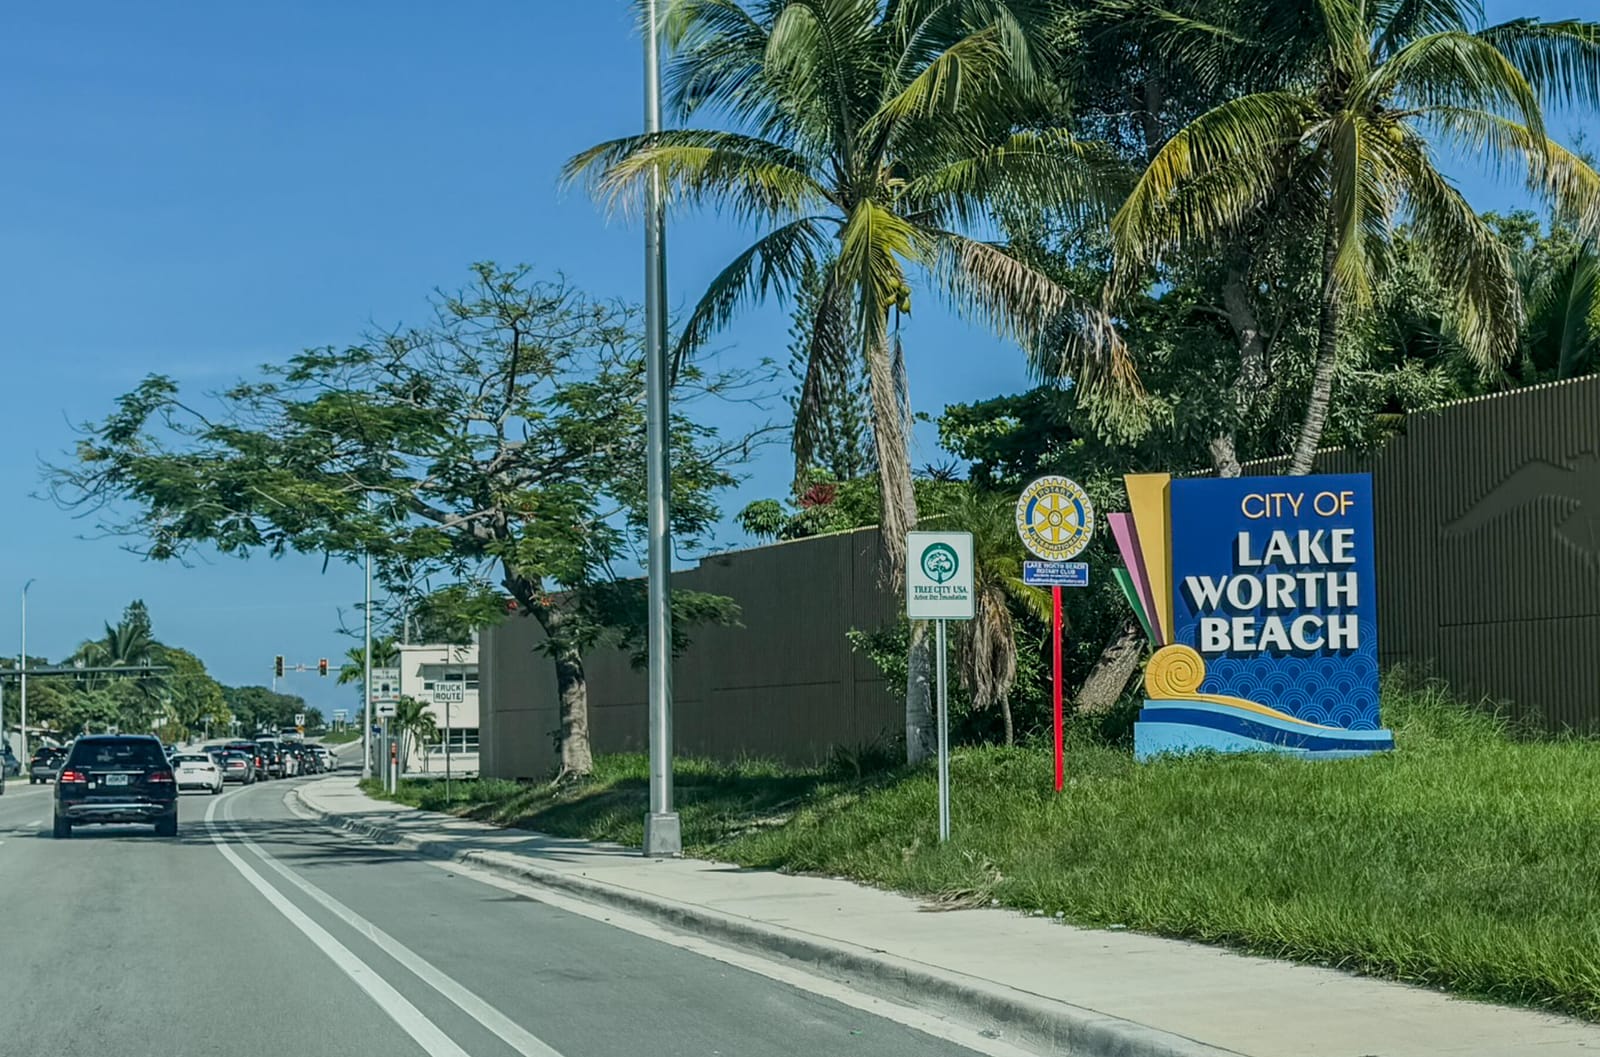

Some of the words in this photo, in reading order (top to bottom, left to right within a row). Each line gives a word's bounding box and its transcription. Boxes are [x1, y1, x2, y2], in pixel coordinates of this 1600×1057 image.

[1037, 486, 1071, 498] ROTARY
[1241, 493, 1304, 518] CITY
[1313, 491, 1354, 516] OF
[1030, 531, 1080, 550] INTERNATIONAL
[1238, 528, 1356, 566] LAKE
[934, 586, 952, 594] CITY
[1185, 571, 1359, 611] WORTH
[1200, 614, 1359, 652] BEACH
[436, 684, 461, 692] TRUCK
